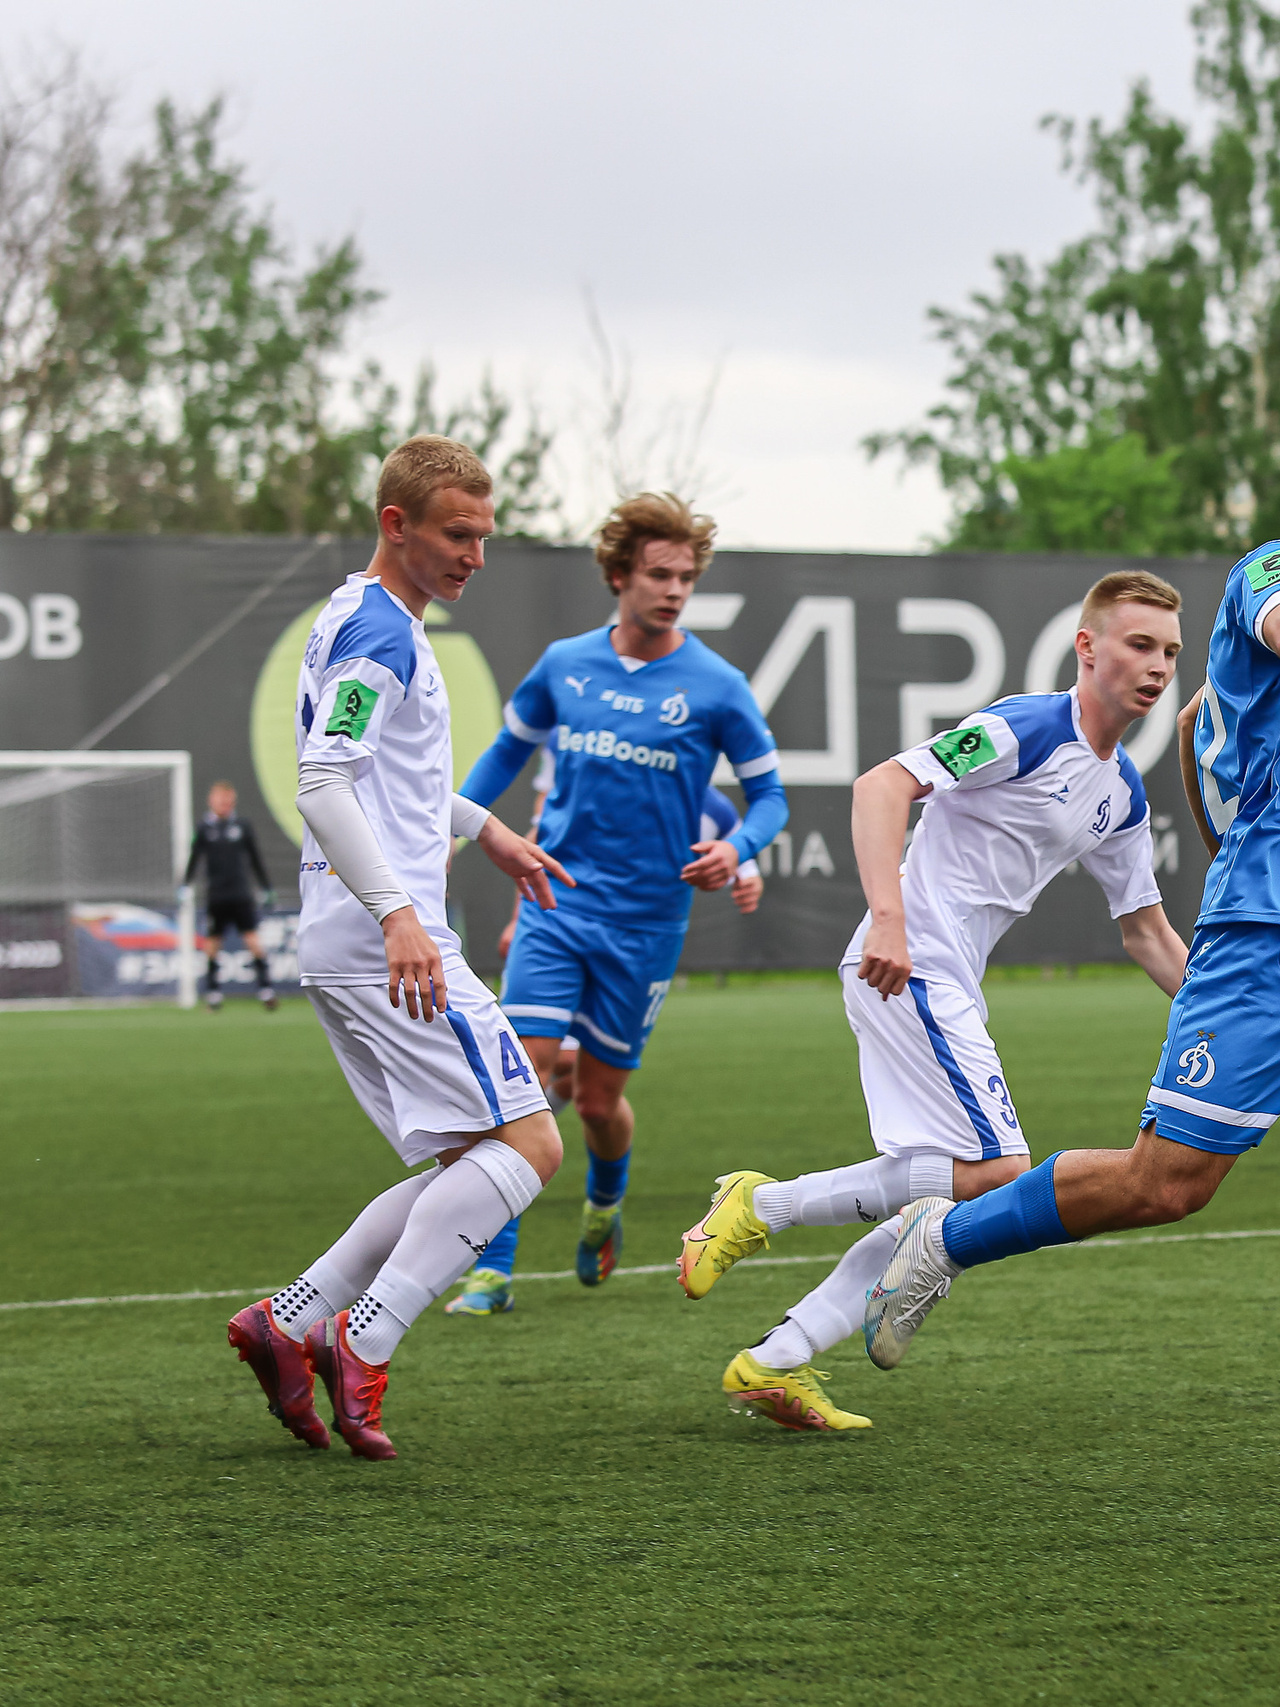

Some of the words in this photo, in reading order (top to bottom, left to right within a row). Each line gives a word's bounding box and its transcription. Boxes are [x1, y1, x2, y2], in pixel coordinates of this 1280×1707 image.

[611, 693, 646, 714] ВТБ
[557, 724, 678, 772] BetBoom
[499, 1030, 533, 1085] 4
